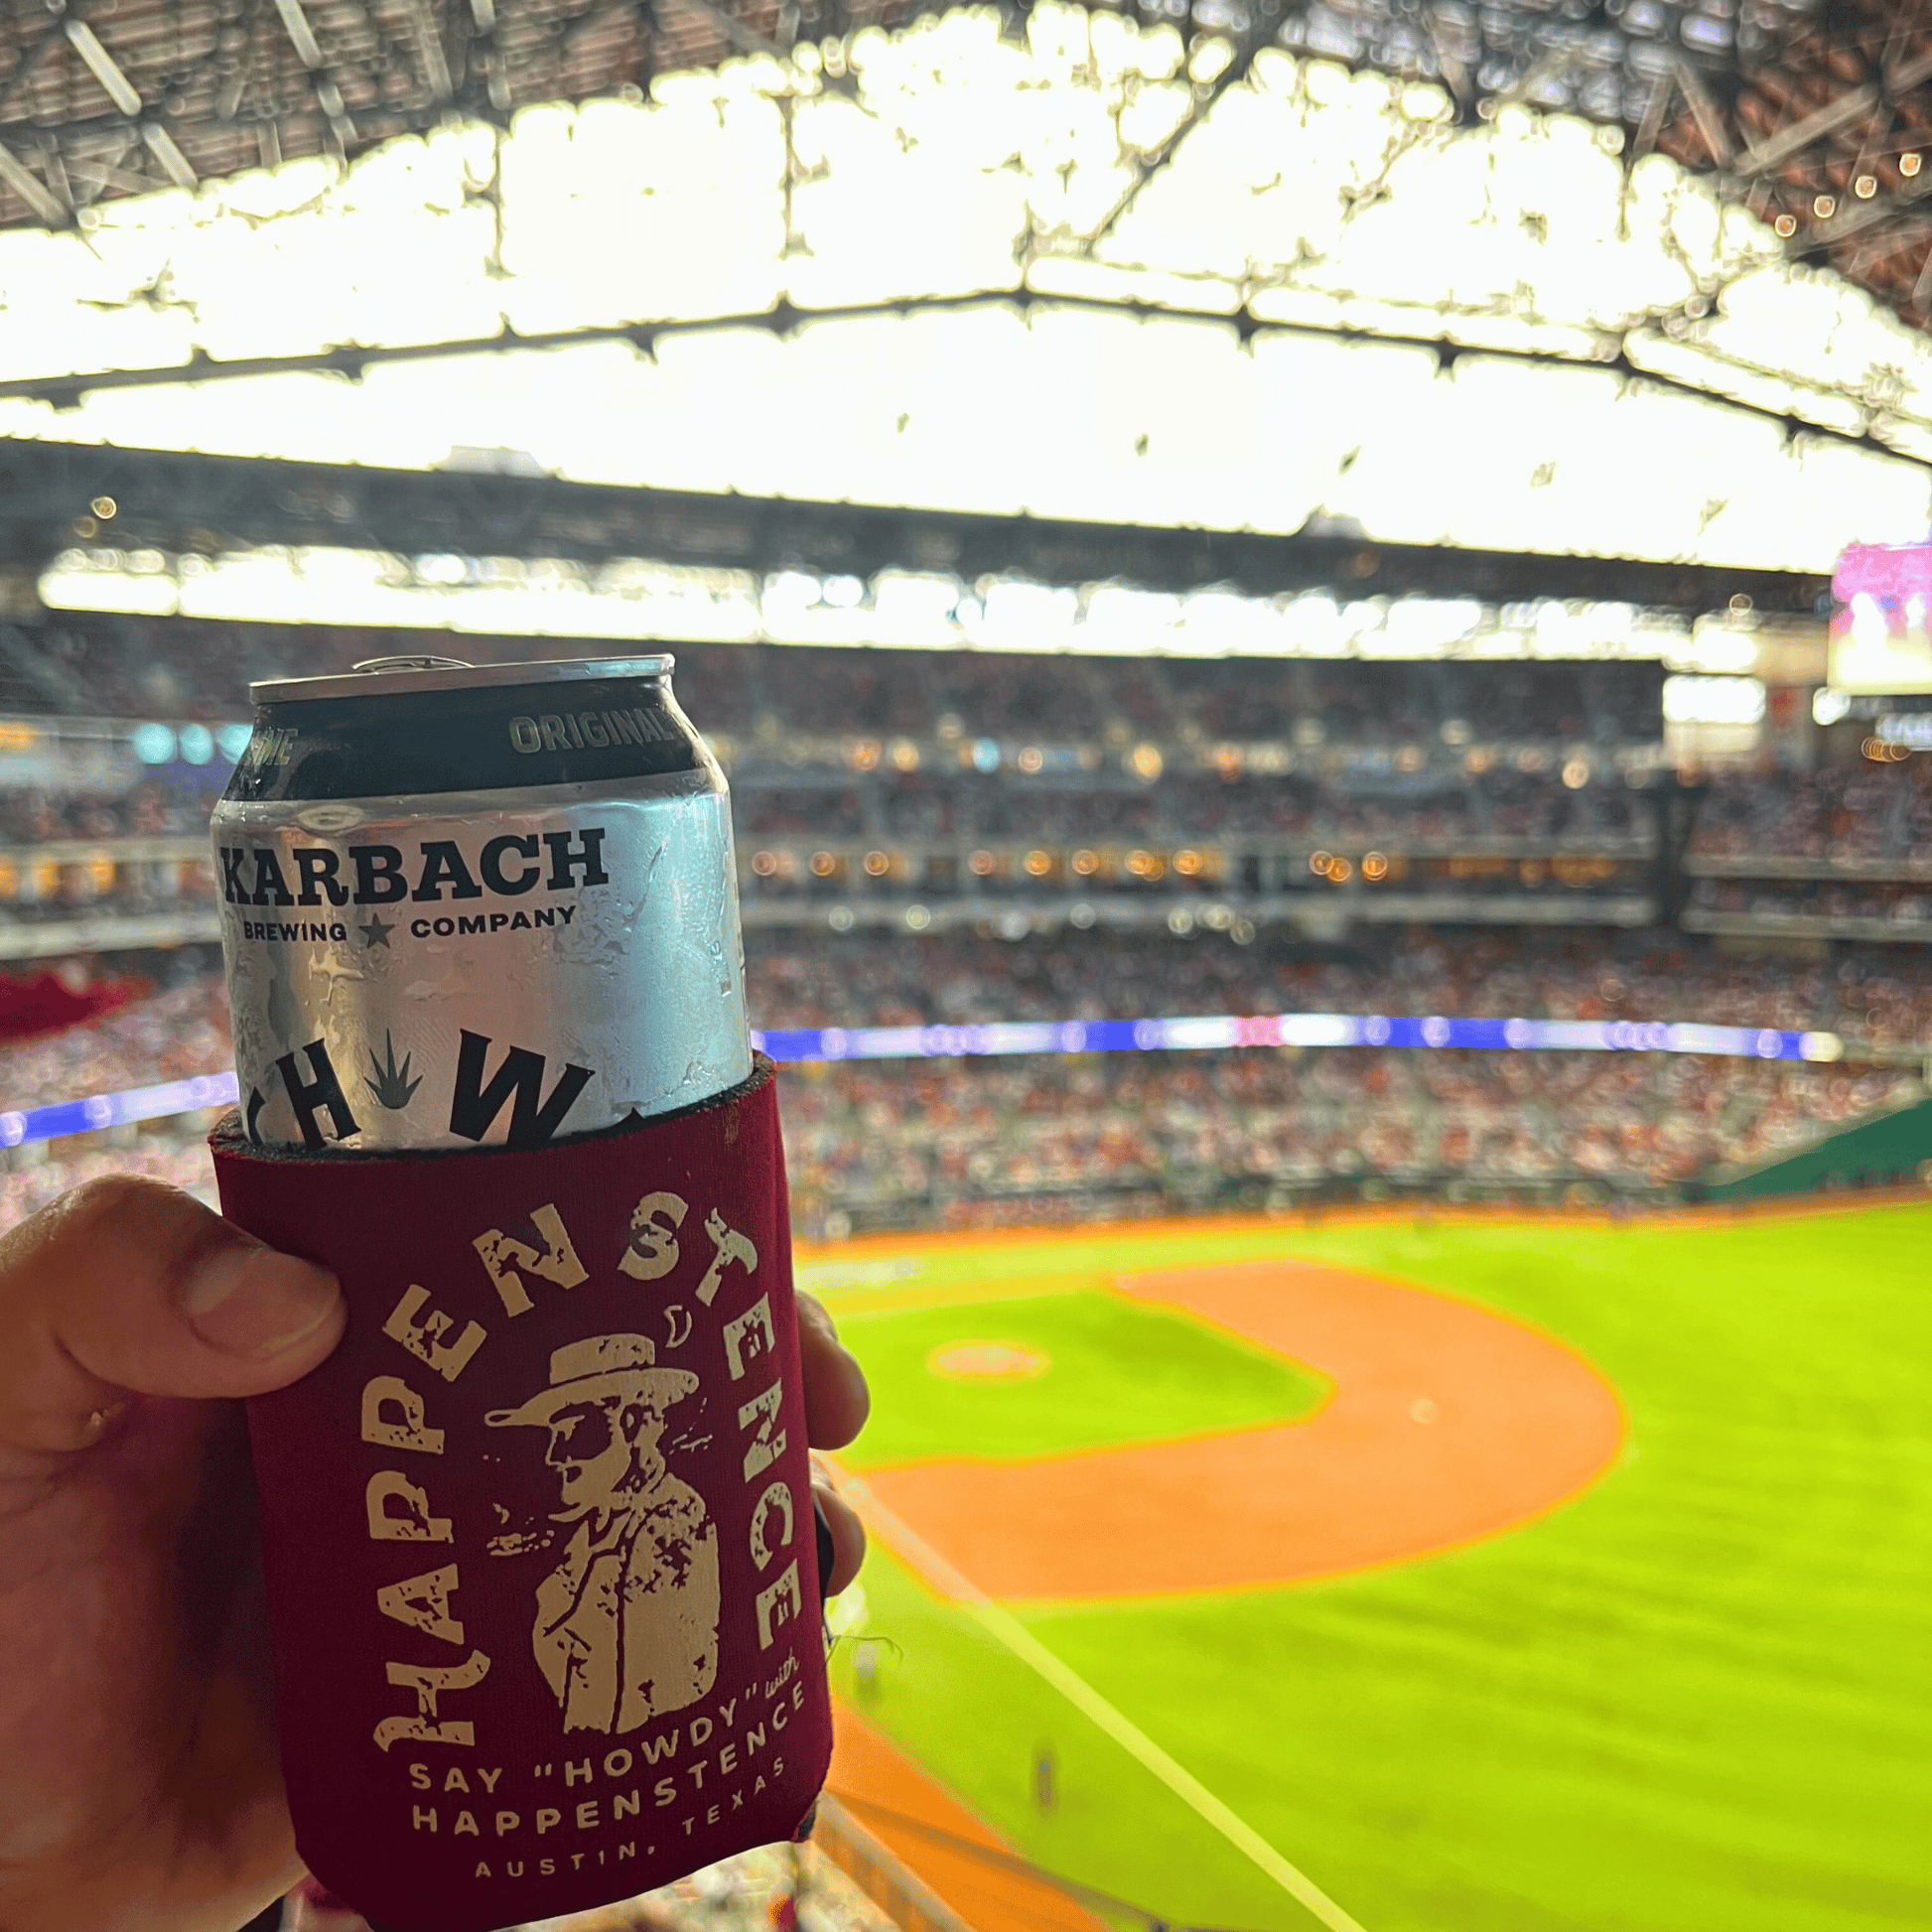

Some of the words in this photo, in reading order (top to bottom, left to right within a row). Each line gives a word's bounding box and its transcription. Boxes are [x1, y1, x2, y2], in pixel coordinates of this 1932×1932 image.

[509, 708, 674, 754] ORIGINAL
[220, 828, 609, 906] KARBACH
[243, 921, 347, 941] BREWING
[411, 905, 576, 938] COMPANY
[409, 1763, 502, 1794] SAY
[765, 1646, 800, 1699] with
[412, 1680, 805, 1837] HAPPENSTENCE
[681, 1756, 784, 1836] TEXAS
